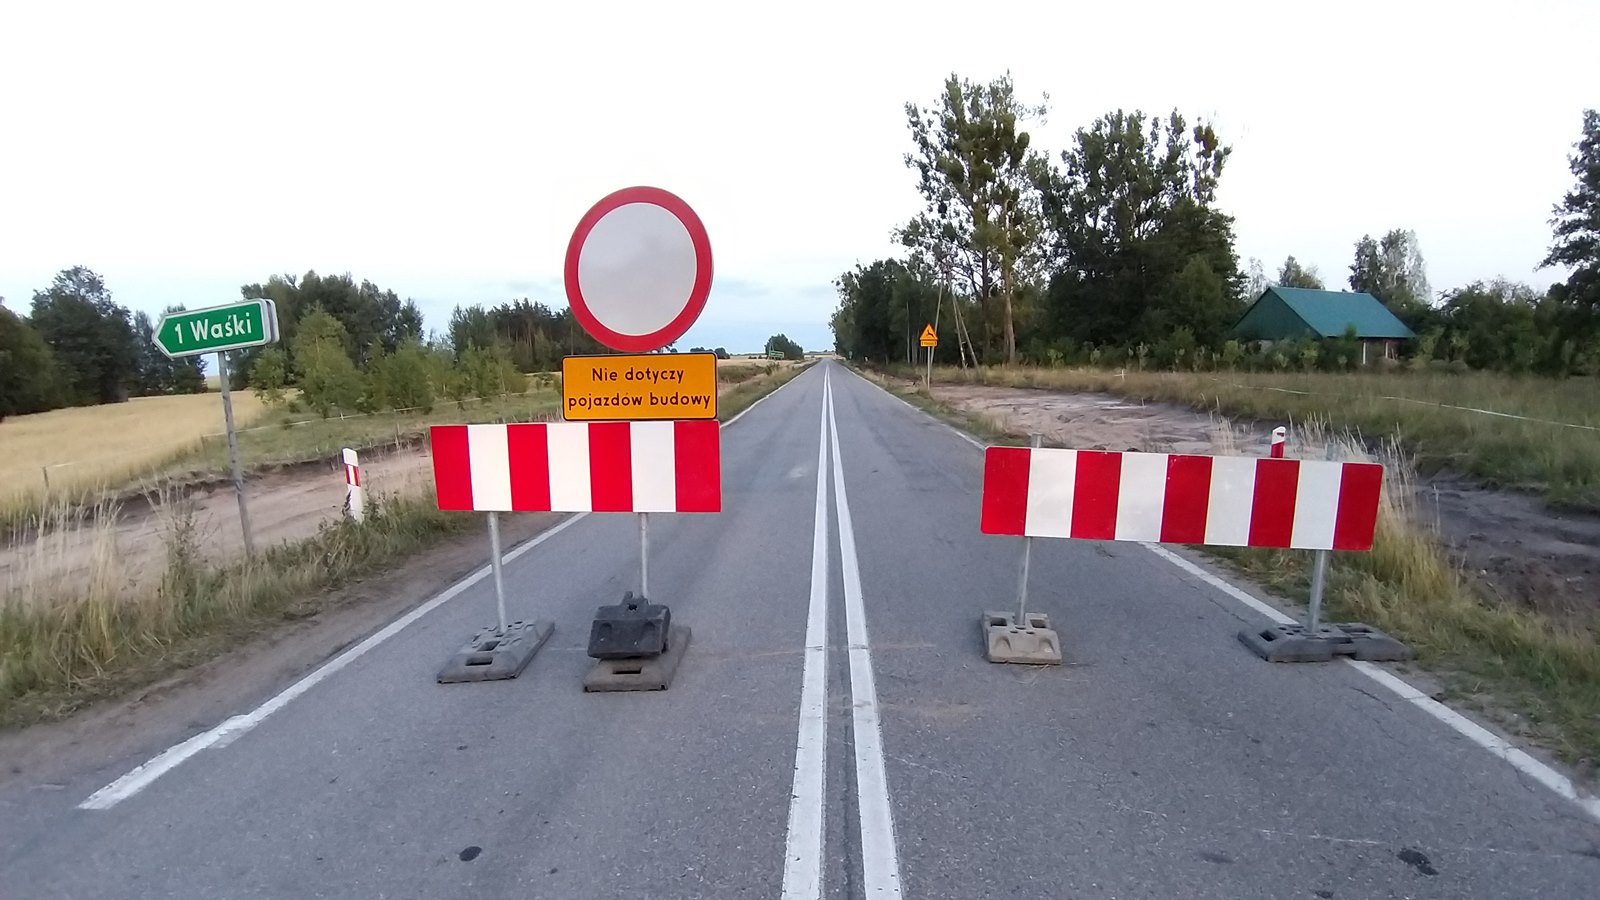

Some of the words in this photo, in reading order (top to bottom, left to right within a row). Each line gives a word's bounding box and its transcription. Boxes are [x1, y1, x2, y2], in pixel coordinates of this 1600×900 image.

[174, 323, 183, 344] 1
[189, 312, 252, 341] Waśki
[592, 368, 618, 381] Nie
[625, 367, 684, 384] dotyczy
[568, 392, 643, 411] pojazdów
[649, 391, 711, 409] budowy
